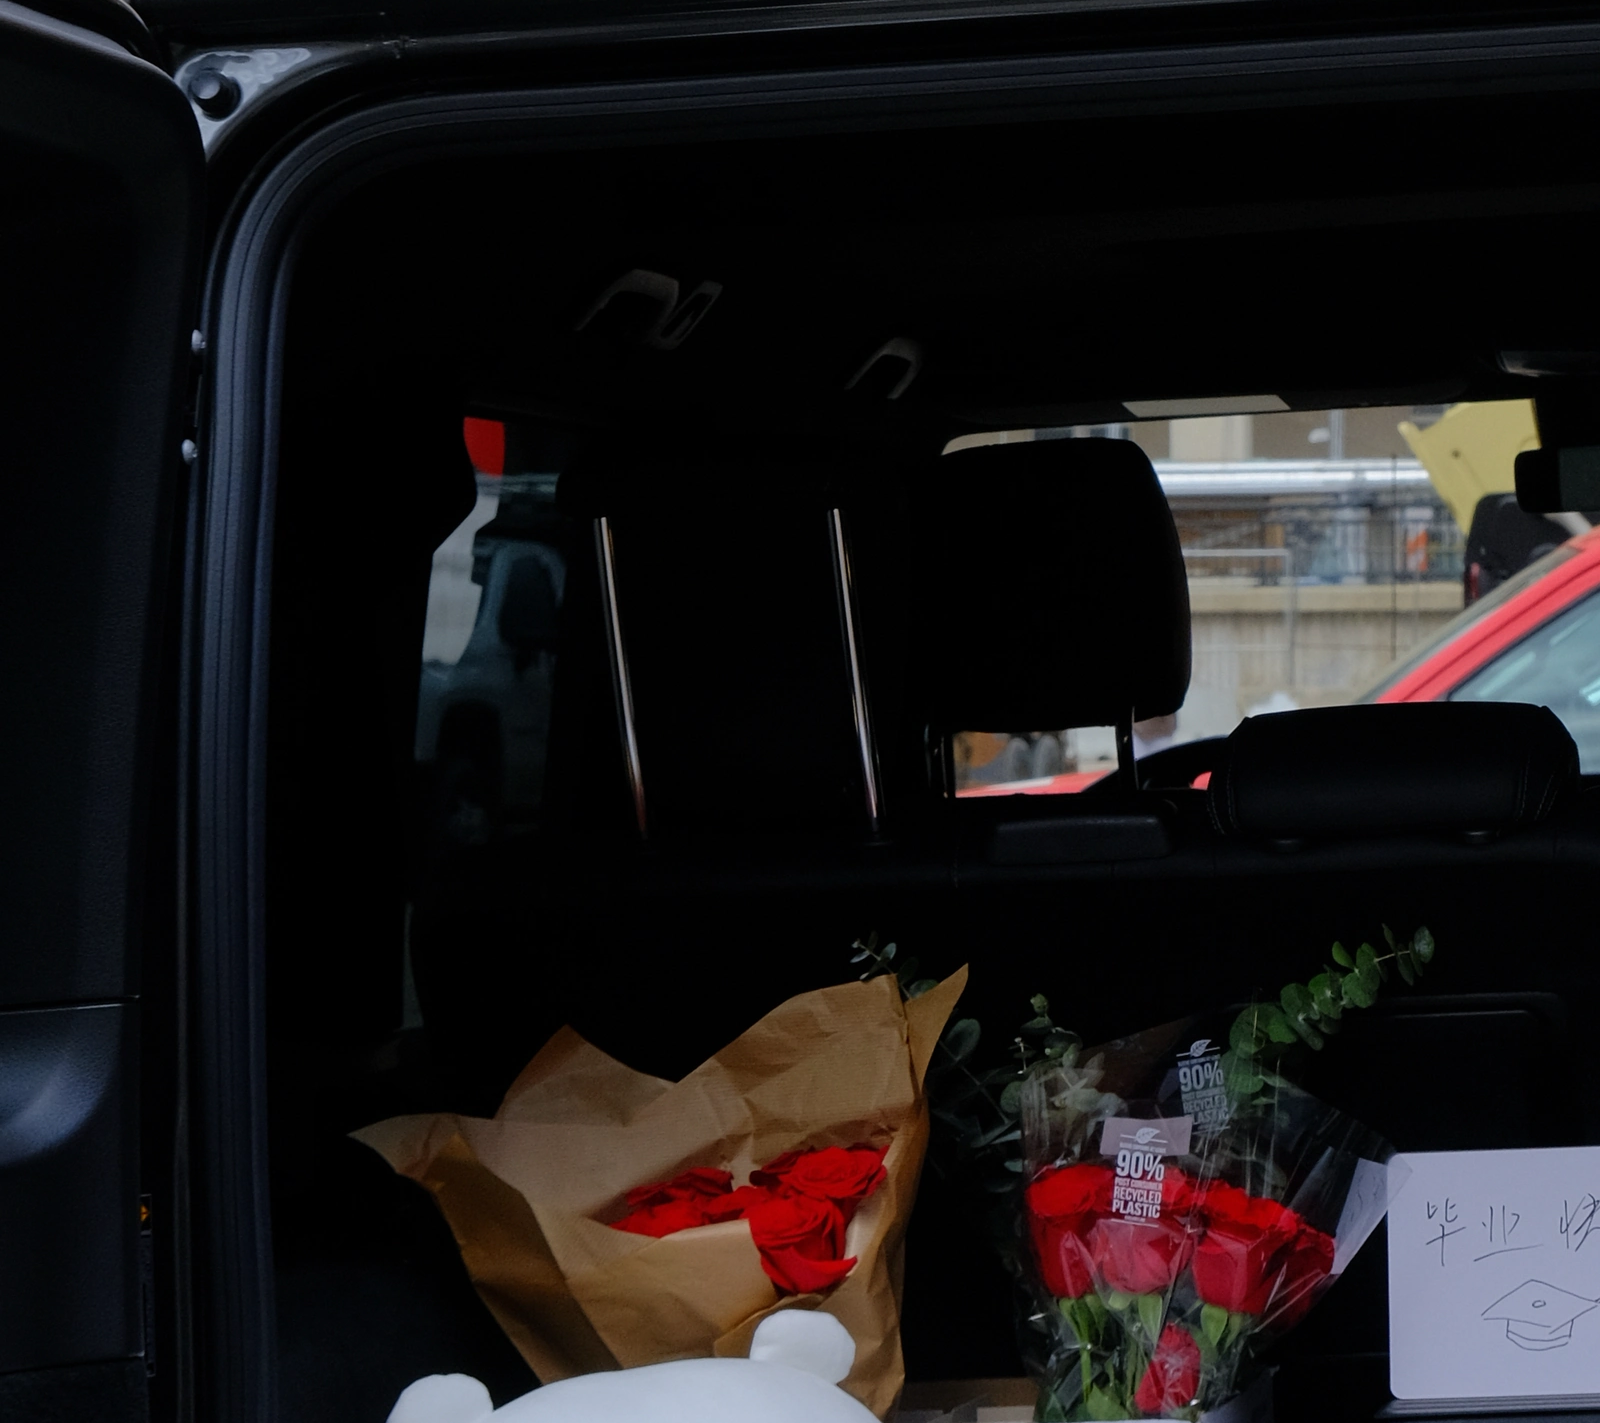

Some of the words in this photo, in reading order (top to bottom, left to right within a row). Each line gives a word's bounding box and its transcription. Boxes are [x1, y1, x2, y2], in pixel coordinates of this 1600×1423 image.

[1179, 1061, 1225, 1092] 90%
[1190, 1108, 1230, 1125] LASTIC
[1116, 1149, 1165, 1181] 90%
[1113, 1186, 1162, 1205] RECYCLED
[1112, 1199, 1161, 1219] PLASTIC
